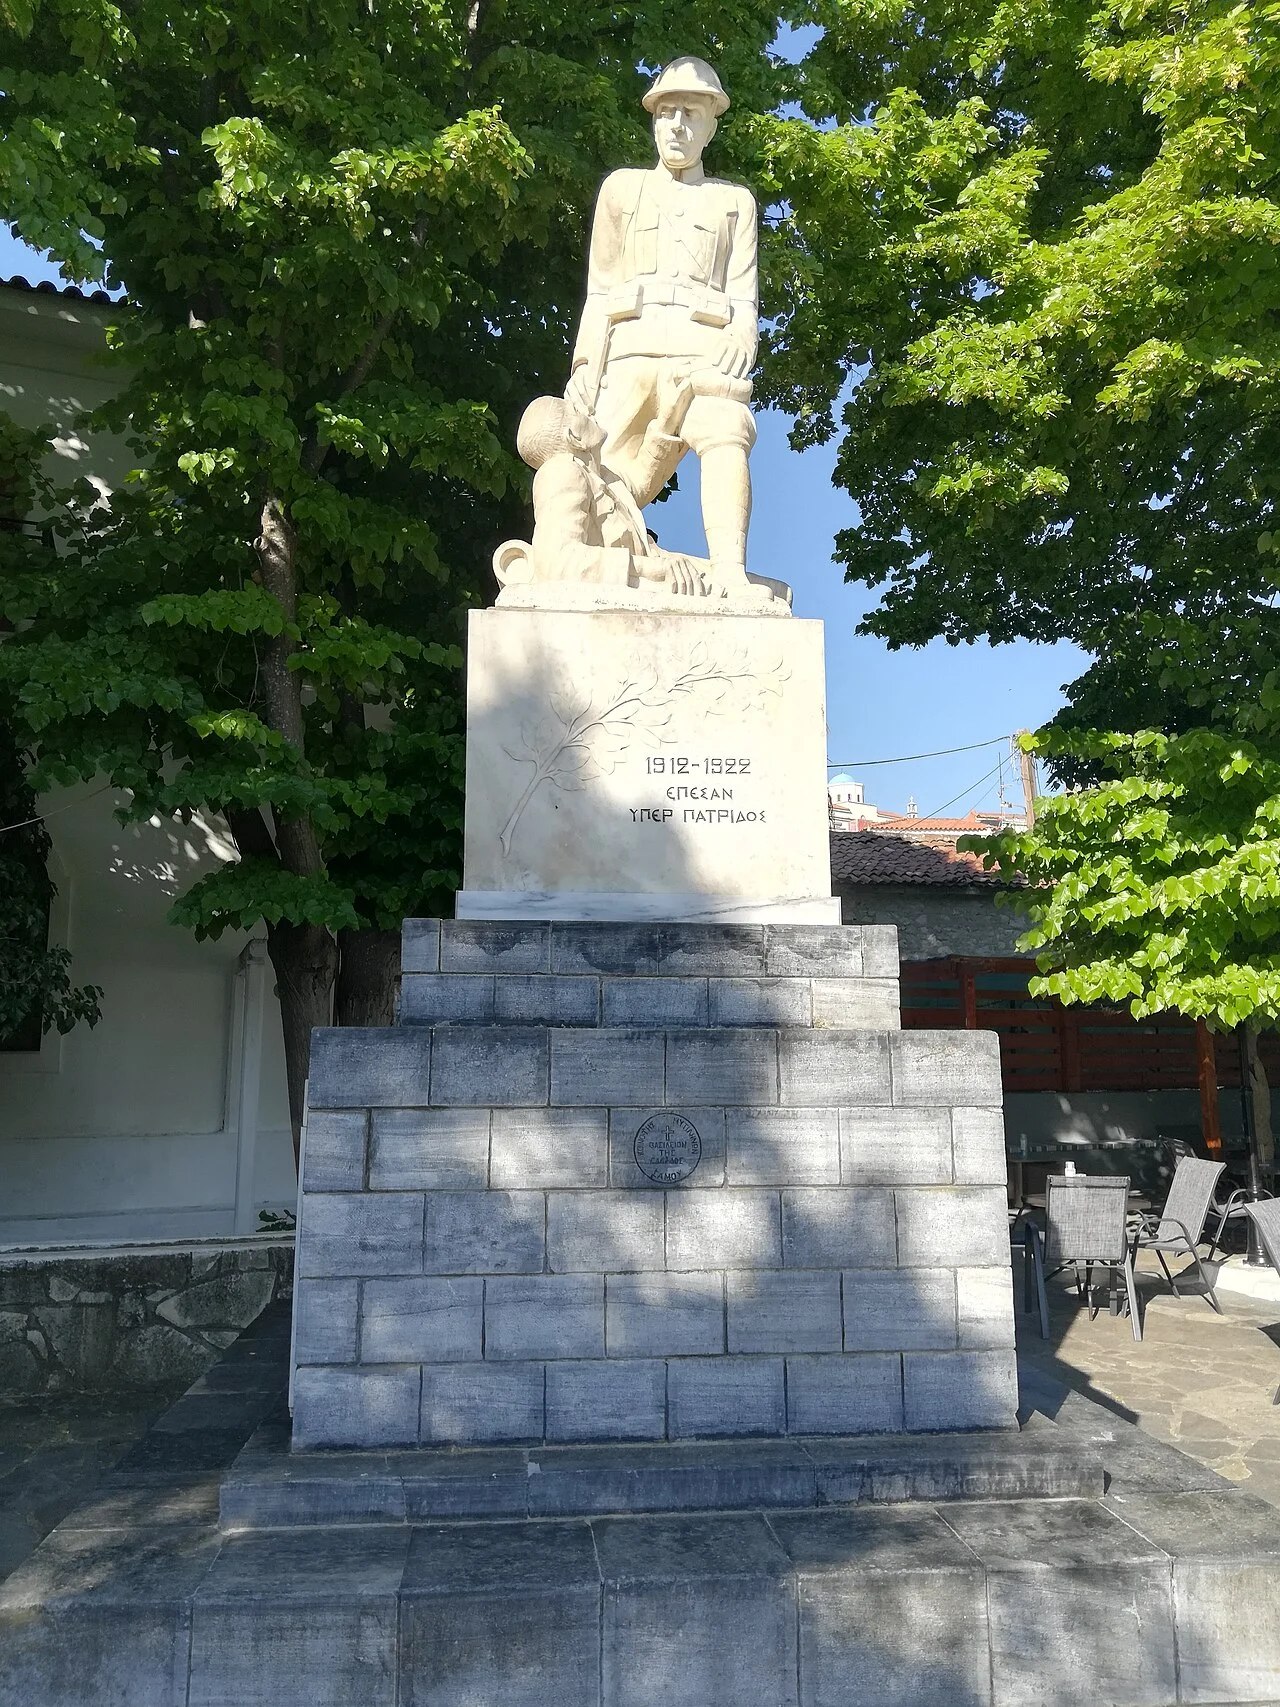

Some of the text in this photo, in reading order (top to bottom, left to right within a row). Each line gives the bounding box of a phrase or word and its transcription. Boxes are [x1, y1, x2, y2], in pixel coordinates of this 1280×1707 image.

[645, 757, 751, 774] 1912-1922
[666, 786, 733, 801] ΕΠΕΣΑΝ
[629, 808, 767, 824] ΥΠΕΡ ΠΑΤΡΙΔΟΣ
[658, 1149, 676, 1157] ΤΗΣ
